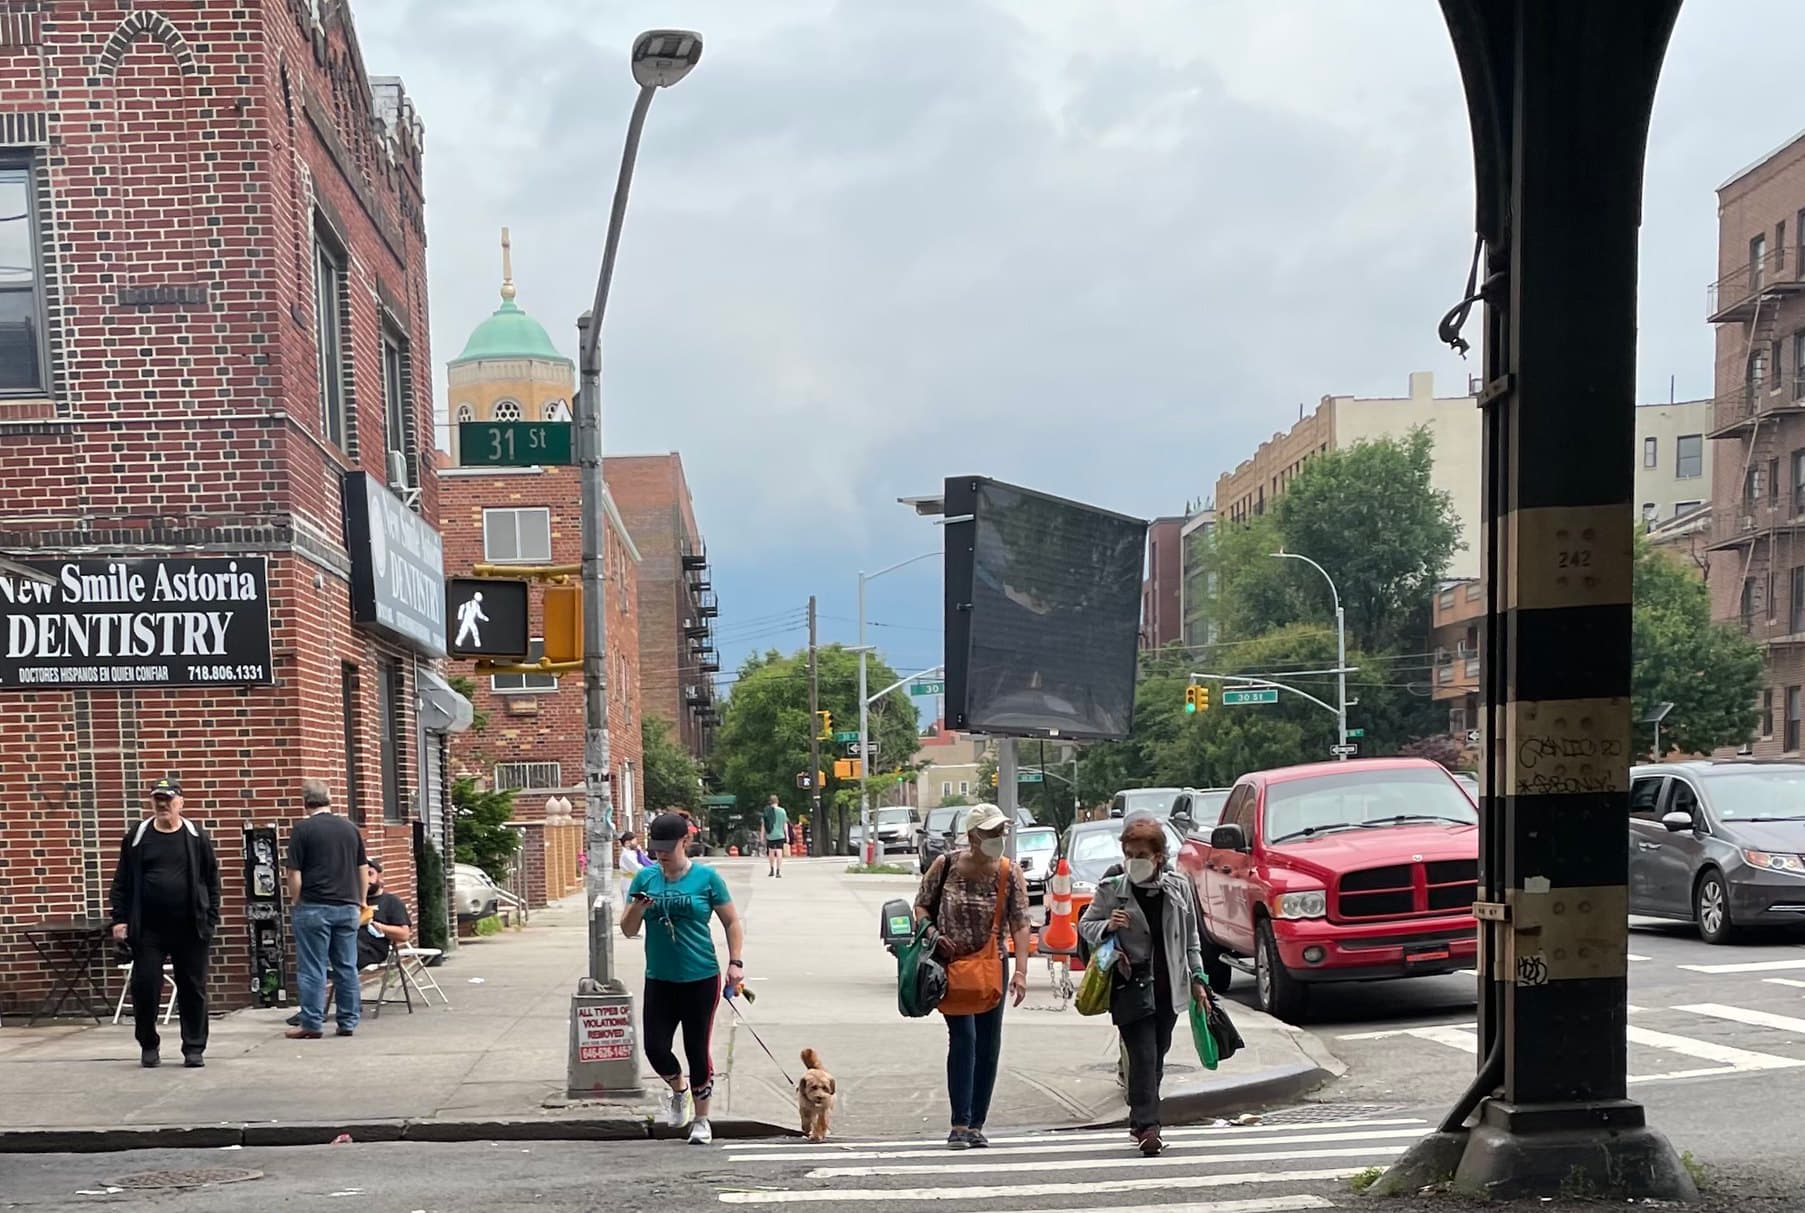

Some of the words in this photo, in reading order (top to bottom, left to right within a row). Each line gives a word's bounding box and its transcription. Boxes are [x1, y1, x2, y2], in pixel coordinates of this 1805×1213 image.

[488, 428, 515, 460] 31
[529, 428, 546, 449] St
[1559, 549, 1592, 569] 242
[61, 562, 146, 603] Smile
[152, 560, 258, 602] Astoria
[5, 611, 235, 659] DENTISTRY
[19, 667, 59, 683] DOCTORES
[60, 666, 98, 682] HISPANOS
[99, 666, 110, 681] EN
[111, 666, 134, 681] QUIEN
[135, 665, 169, 681] CONFIAR
[188, 665, 263, 681] 718.806.1331
[925, 684, 939, 694] 30
[1238, 694, 1250, 702] 30
[579, 1008, 593, 1018] ALL
[594, 1007, 618, 1017] TYPES
[587, 1028, 625, 1040] REMOVED
